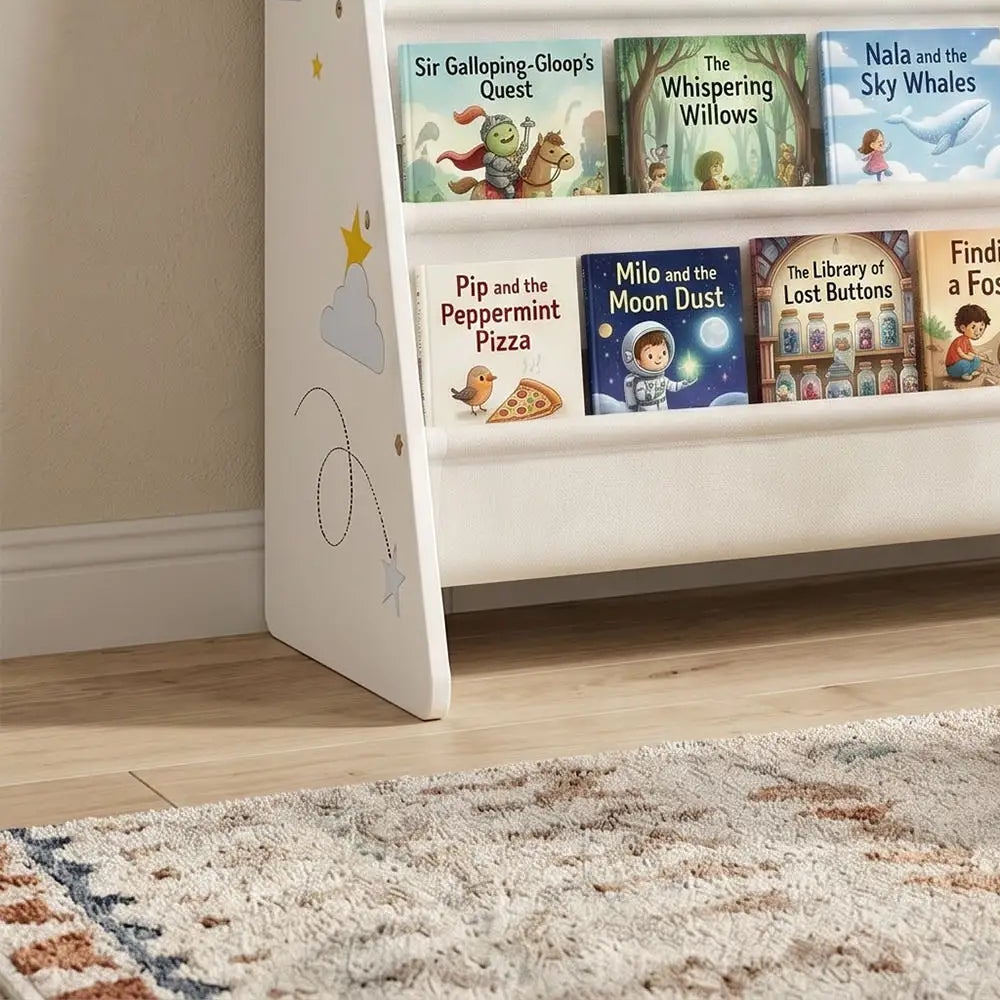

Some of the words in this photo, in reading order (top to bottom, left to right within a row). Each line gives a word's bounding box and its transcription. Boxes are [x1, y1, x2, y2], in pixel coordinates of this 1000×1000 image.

[704, 56, 730, 72] The
[866, 42, 911, 66] Nala
[916, 50, 942, 64] and
[945, 48, 967, 64] the
[415, 57, 440, 77] Sir
[445, 52, 594, 81] Galloping-Gloop's
[480, 79, 533, 101] Quest
[661, 76, 773, 102] Whispering
[861, 72, 897, 102] Sky
[902, 70, 976, 94] Whales
[680, 103, 758, 126] Willows
[616, 261, 660, 285] Milo
[665, 268, 691, 282] and
[694, 265, 717, 281] the
[787, 264, 809, 280] The
[813, 260, 866, 282] Library
[871, 260, 885, 276] of
[456, 274, 488, 302] Pip
[493, 280, 520, 295] and
[524, 277, 548, 294] the
[784, 285, 821, 305] Lost
[826, 281, 893, 301] Buttons
[949, 278, 961, 295] a
[610, 288, 668, 315] Moon
[676, 287, 725, 310] Dust
[441, 299, 561, 329] Peppermint
[476, 330, 531, 353] Pizza
